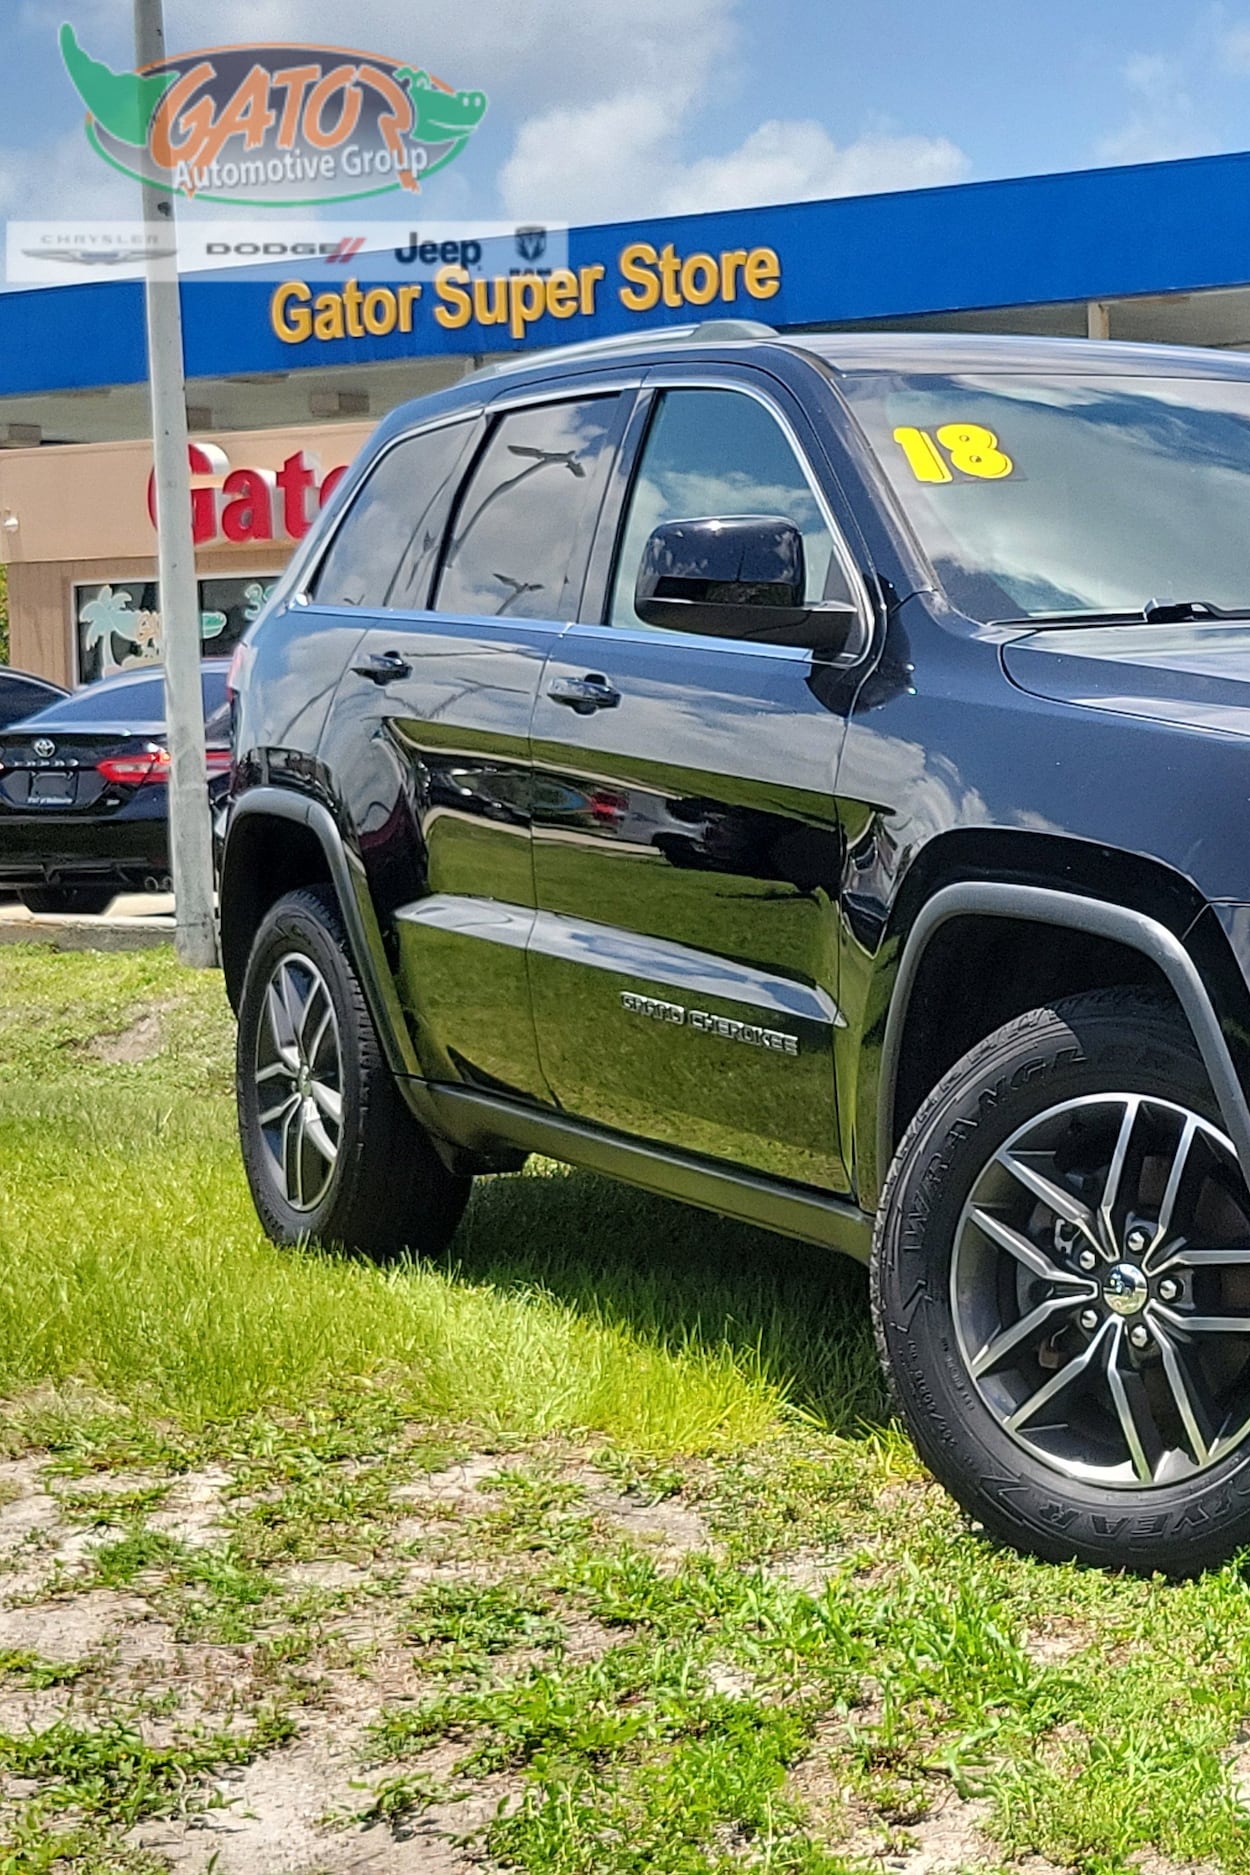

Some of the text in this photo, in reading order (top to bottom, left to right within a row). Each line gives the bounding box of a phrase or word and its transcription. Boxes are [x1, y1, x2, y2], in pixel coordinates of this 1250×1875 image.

[271, 241, 781, 345] Gator Super Store
[892, 422, 1013, 484] 18
[619, 990, 799, 1056] GRAND CHEROKEE
